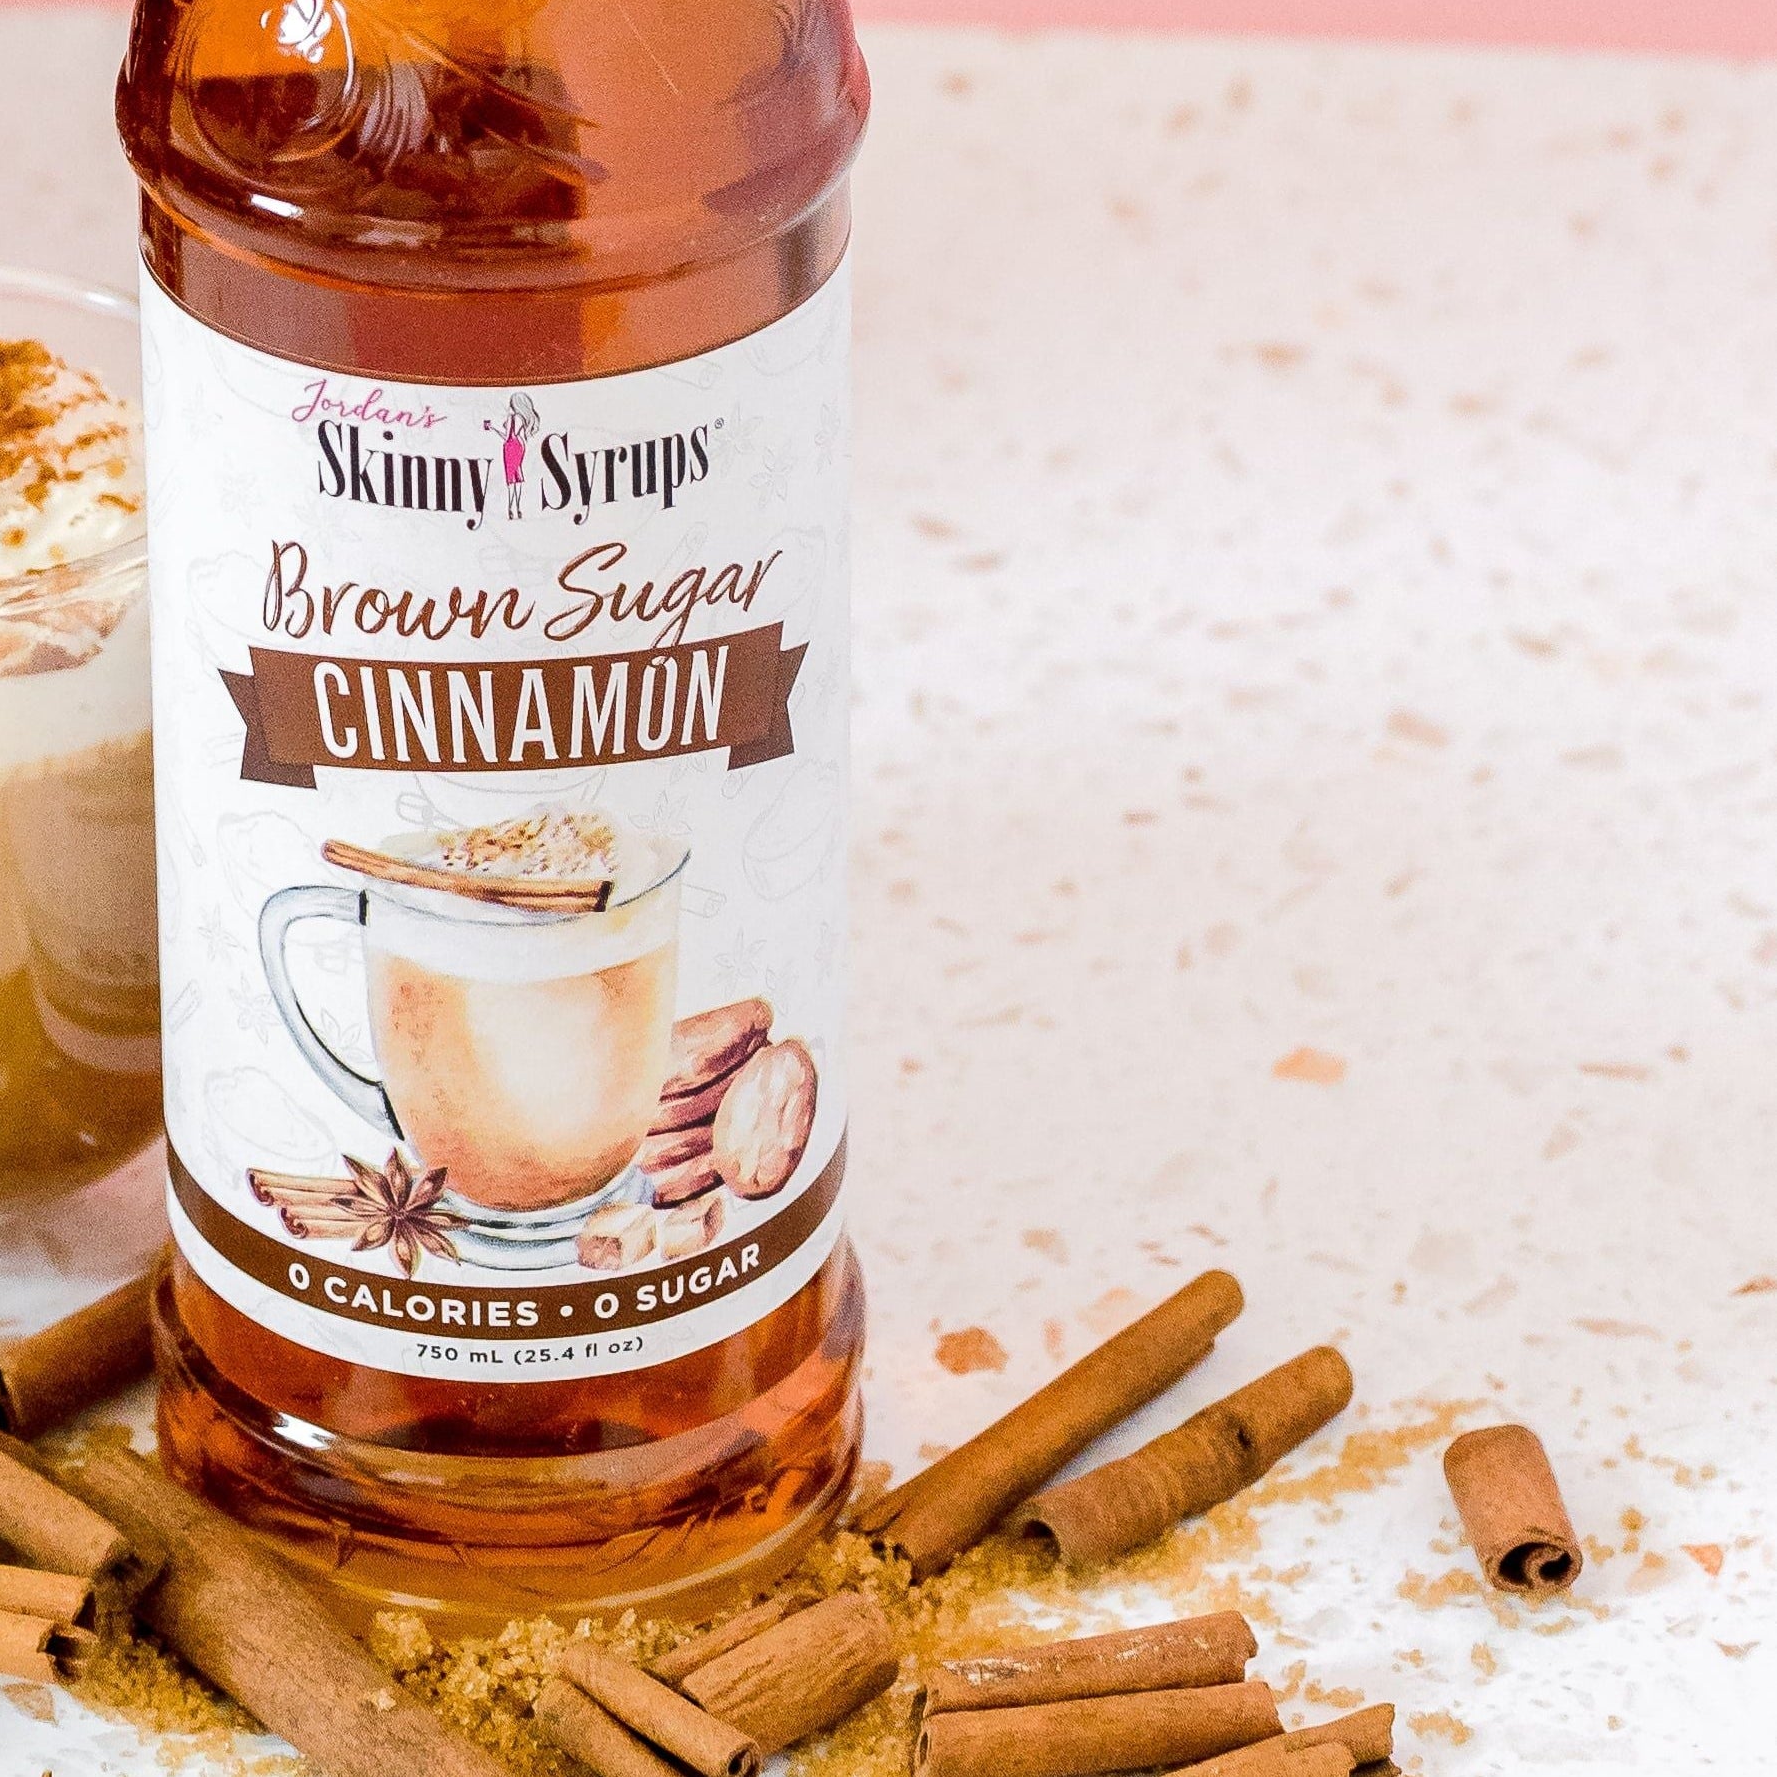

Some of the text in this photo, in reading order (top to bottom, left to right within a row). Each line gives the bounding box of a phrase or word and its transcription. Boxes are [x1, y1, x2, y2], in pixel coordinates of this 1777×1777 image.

[291, 378, 448, 429] Jordan's
[317, 419, 710, 531] Skinny Syrups
[262, 539, 783, 665] Brown Sugar
[313, 643, 730, 764] CINNAMON
[324, 1276, 539, 1327] CALORIES
[636, 1243, 761, 1312] SUGAR
[416, 1336, 644, 1366] 750 mL (25.4 fl oz)
